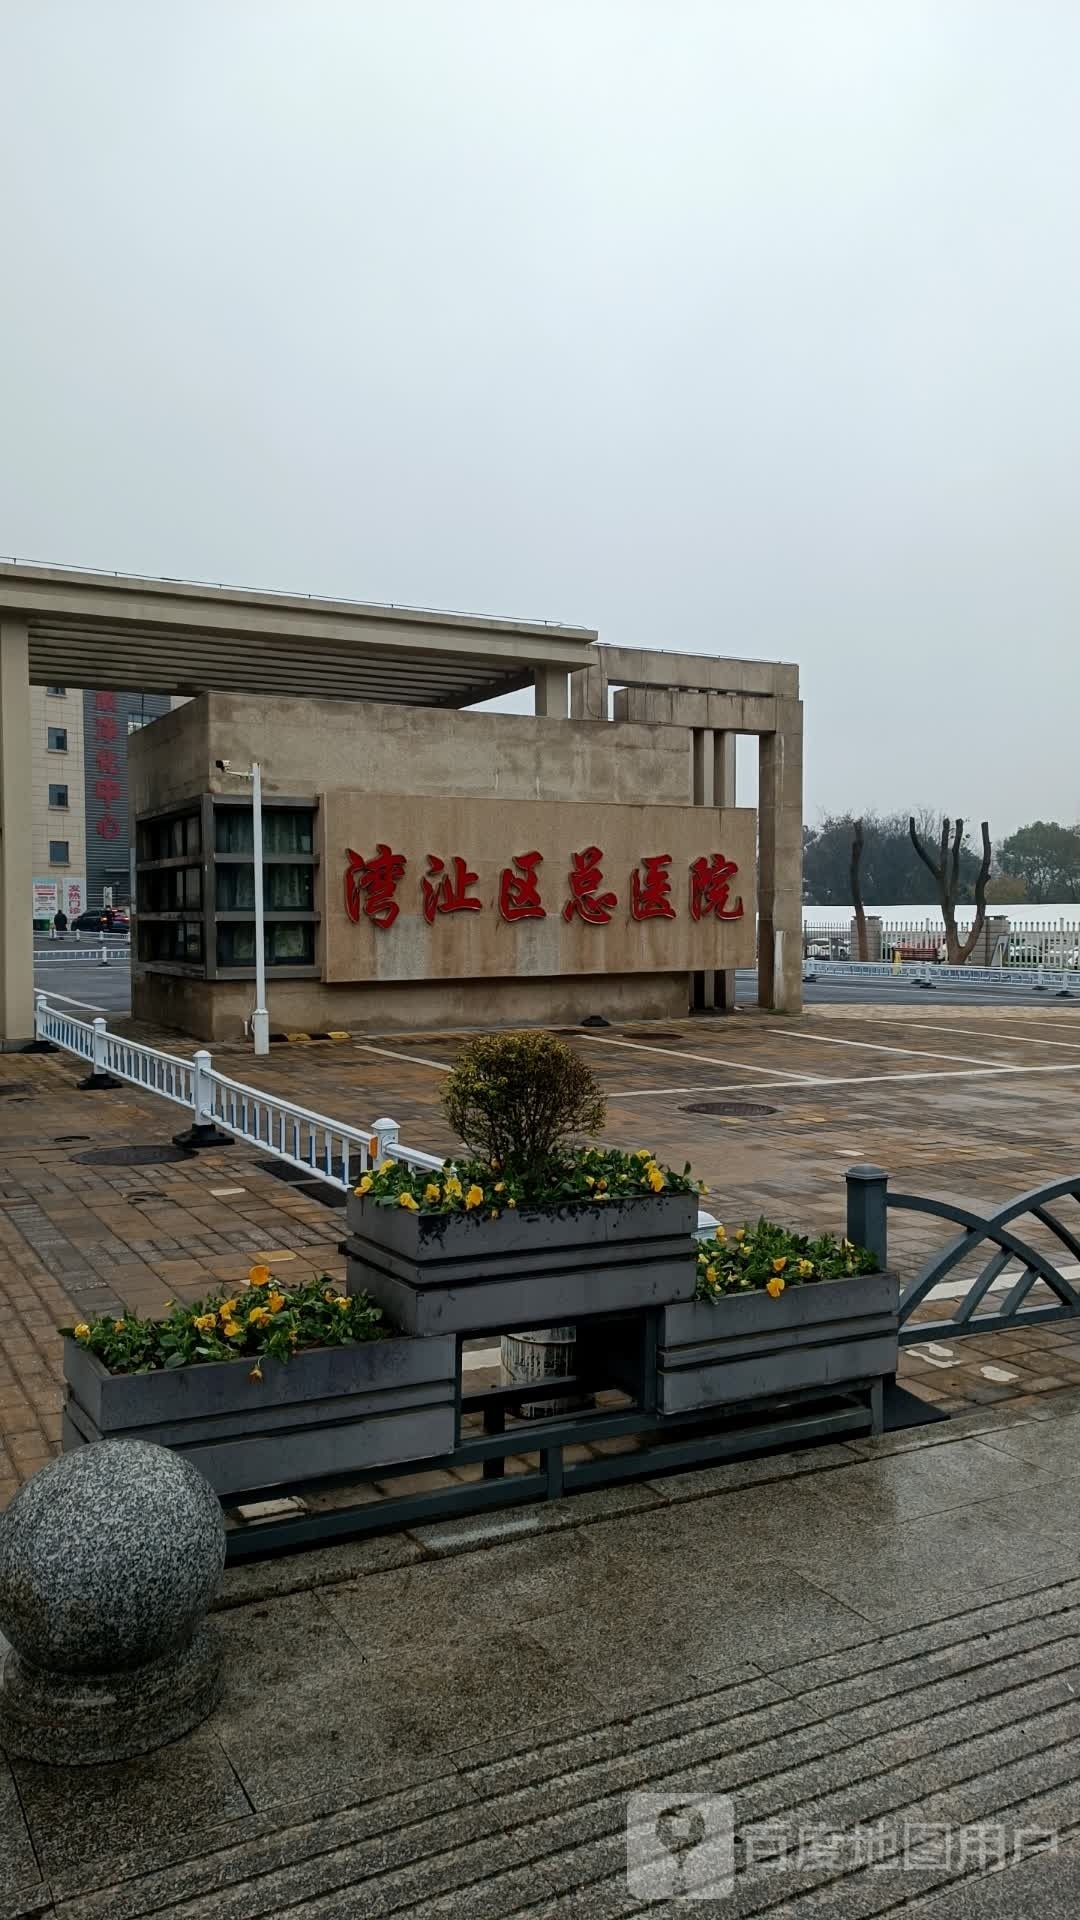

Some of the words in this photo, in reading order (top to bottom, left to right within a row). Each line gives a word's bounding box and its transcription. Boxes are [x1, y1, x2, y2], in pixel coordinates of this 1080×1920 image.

[344, 844, 744, 929] 湾沚区总医院
